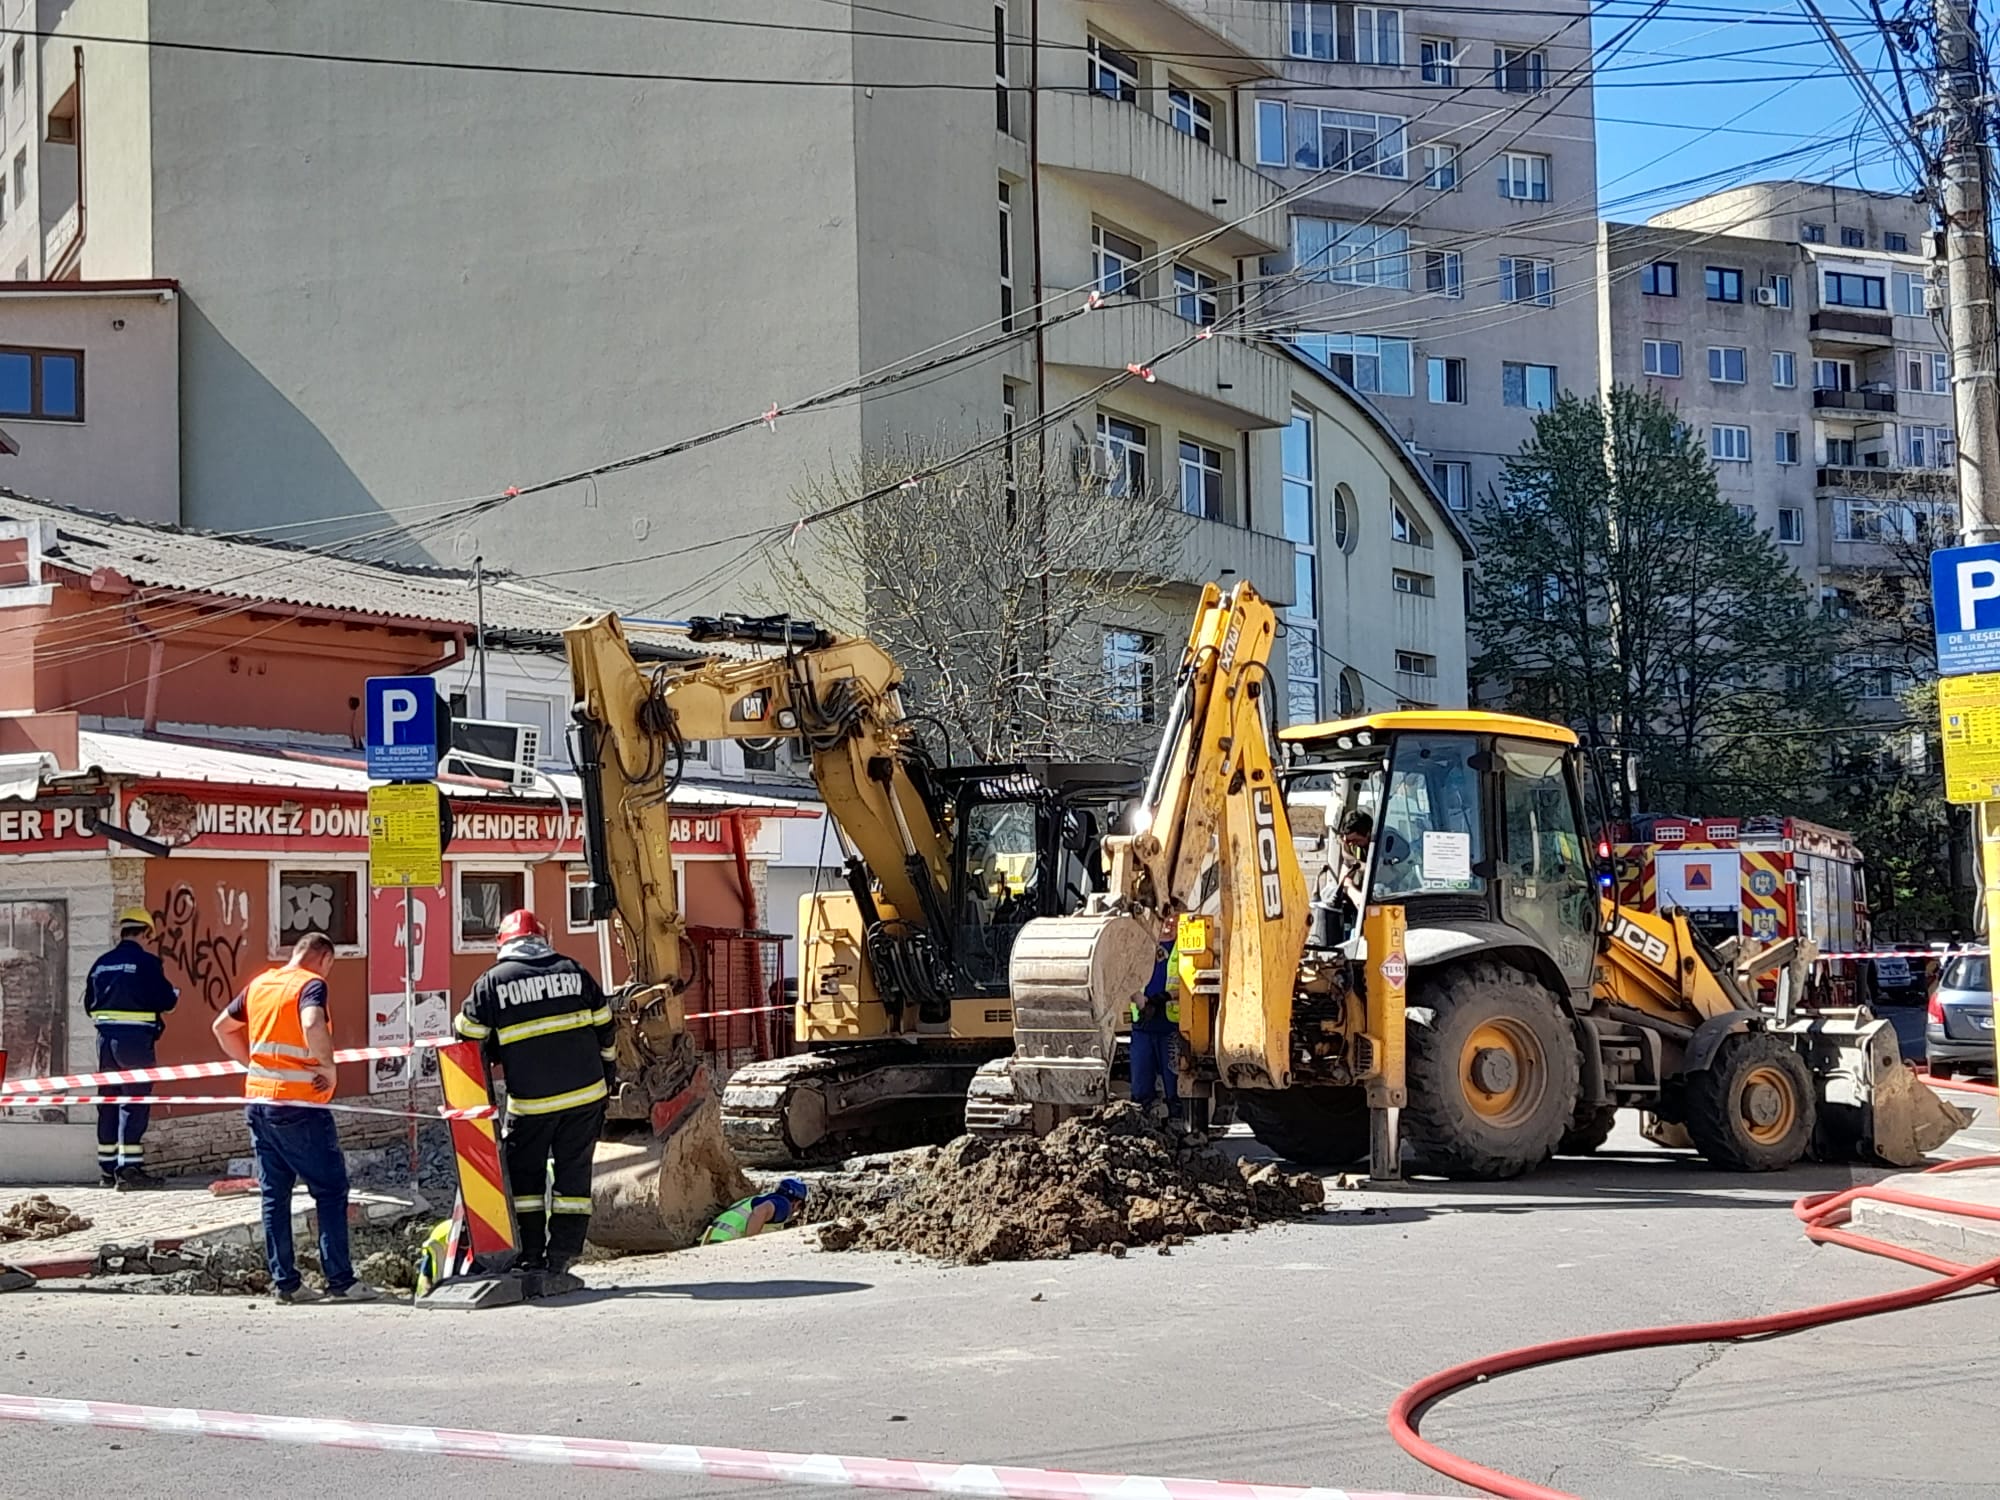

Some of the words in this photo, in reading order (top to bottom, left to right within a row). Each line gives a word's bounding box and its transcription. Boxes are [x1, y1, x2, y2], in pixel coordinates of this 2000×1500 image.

[1956, 559, 2000, 631] P
[1949, 634, 1962, 644] DE
[382, 689, 418, 745] P
[743, 697, 761, 720] CAT
[196, 803, 303, 835] MERKEZ
[695, 820, 721, 842] PUI
[1254, 790, 1281, 918] JCB
[1605, 918, 1667, 964] JCB
